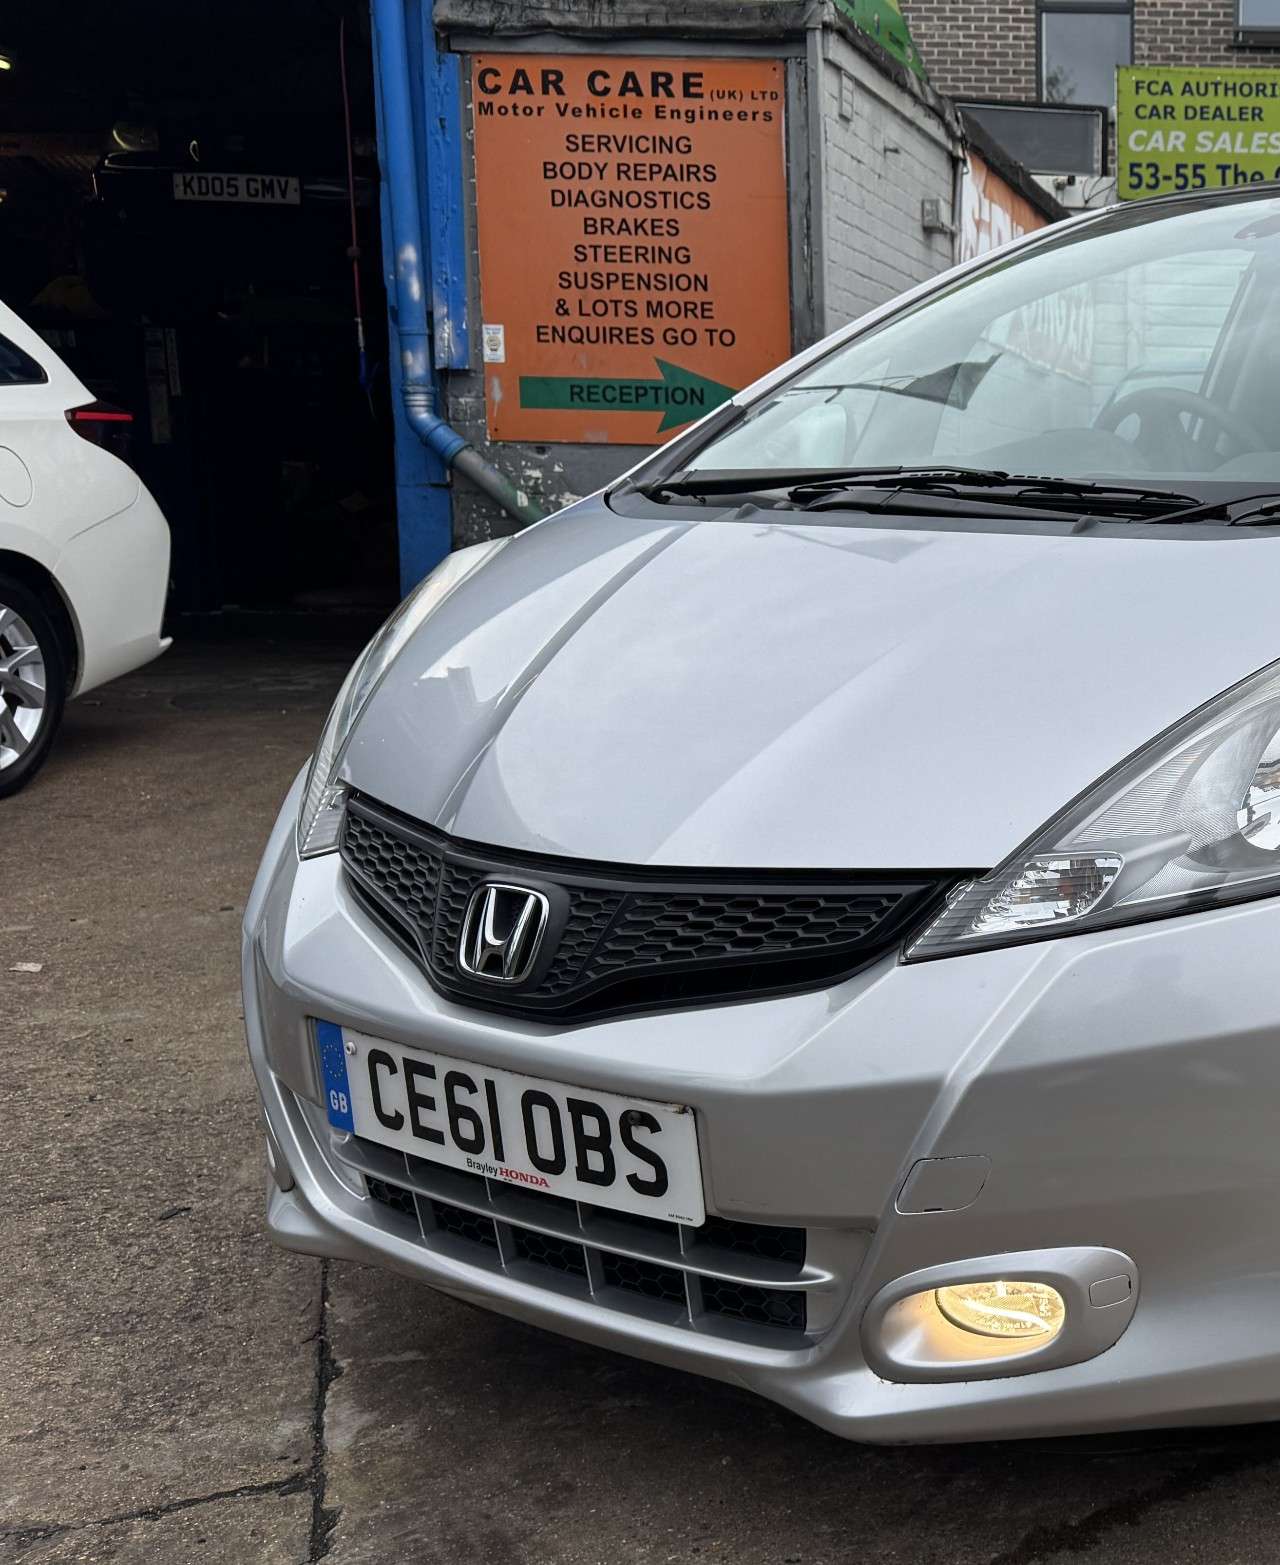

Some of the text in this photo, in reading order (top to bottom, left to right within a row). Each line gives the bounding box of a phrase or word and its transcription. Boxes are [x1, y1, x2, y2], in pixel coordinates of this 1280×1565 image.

[477, 68, 778, 101] CAR CARE (UK) LTD
[1134, 80, 1173, 97] FCA
[478, 102, 774, 124] Motor Vehicle Engineers
[1134, 104, 1264, 121] CAR DEALER
[565, 134, 693, 154] SERVICING
[1128, 130, 1186, 152] CAR
[543, 162, 717, 183] BODY REPAIRS
[1128, 163, 1206, 190] 53-55
[245, 177, 289, 200] GMV
[550, 189, 711, 210] DIAGNOSTICS
[583, 217, 680, 237] BRAKES
[573, 245, 691, 264] STEERING
[558, 272, 709, 292] SUSPENSION
[554, 299, 714, 320] & LOTS MORE
[536, 326, 736, 347] ENQUIRES GO TO
[569, 384, 705, 405] RECEPTION
[329, 1089, 348, 1114] GB
[367, 1048, 669, 1198] CE61 OBS
[466, 1157, 550, 1188] Brayley HONDA
